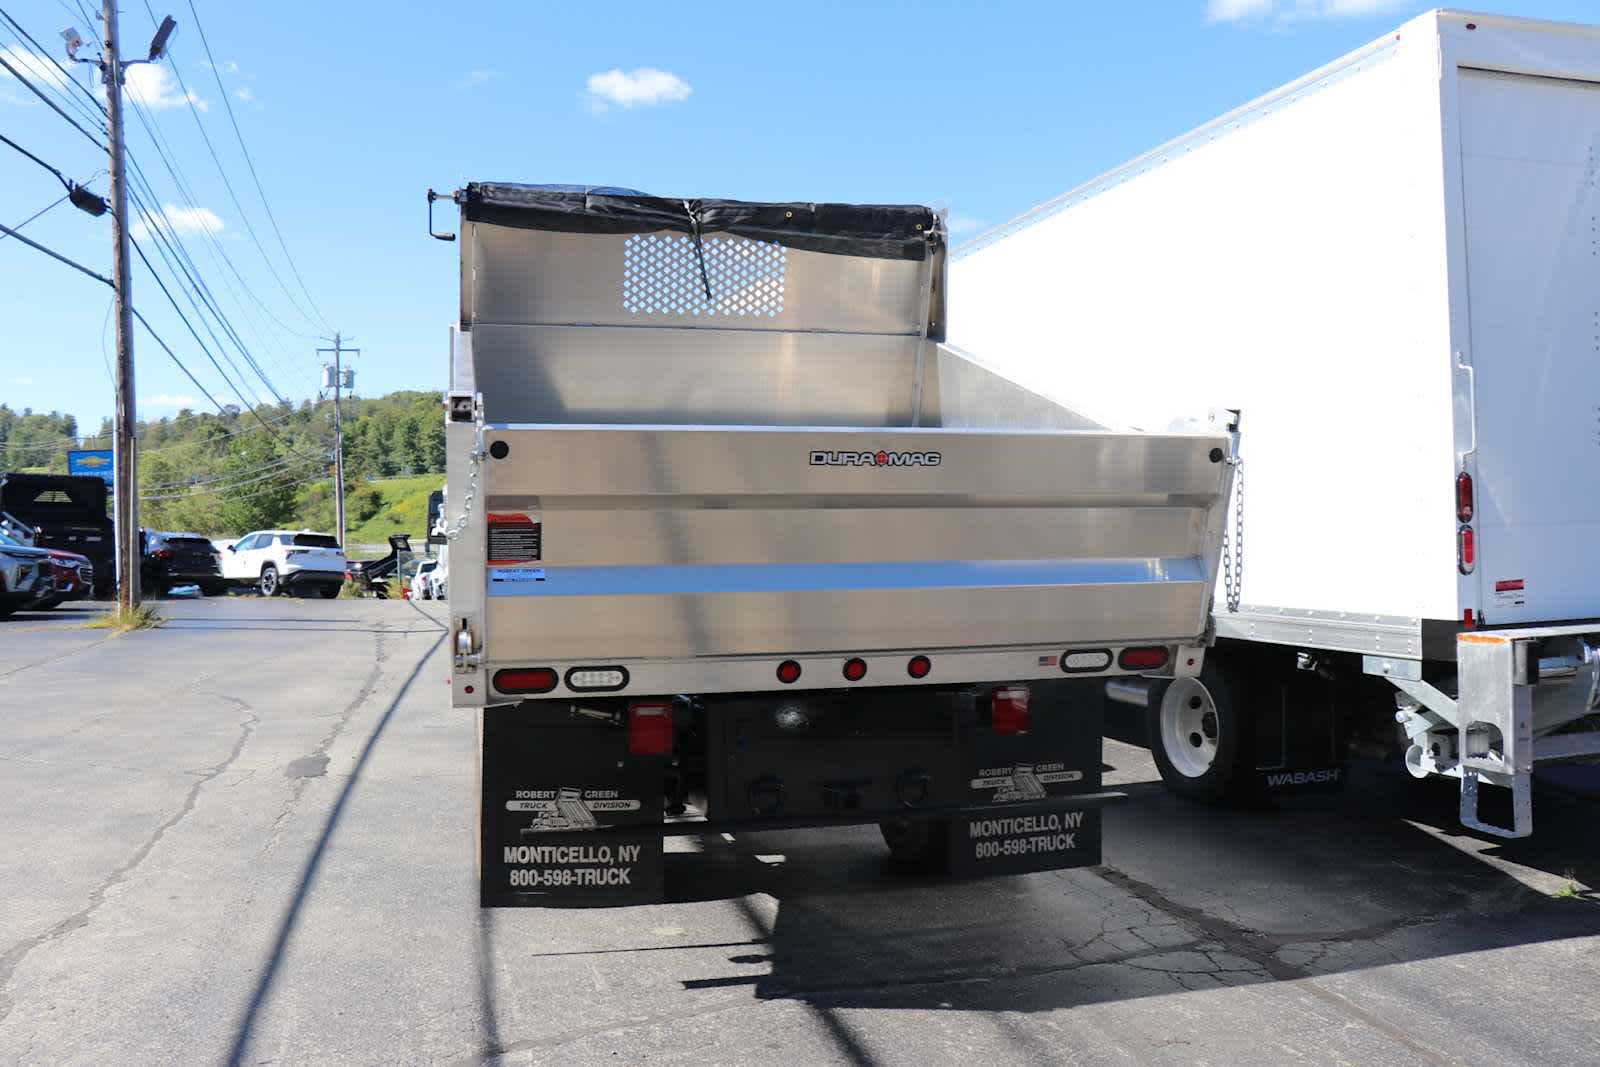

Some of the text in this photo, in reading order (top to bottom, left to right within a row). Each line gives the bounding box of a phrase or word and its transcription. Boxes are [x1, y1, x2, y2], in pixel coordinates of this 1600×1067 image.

[979, 762, 1065, 777] ROBERT GREEN
[1267, 769, 1339, 786] WABASH
[515, 790, 619, 799] ROBERT GREEN
[519, 801, 631, 809] TRUCK DIVISION
[969, 811, 1083, 838] MONTICELLO, NY
[975, 833, 1076, 859] 800-598-TRUCK
[503, 845, 641, 866] MONTICELLO, NY
[509, 868, 632, 887] 800-598-TRUCK
